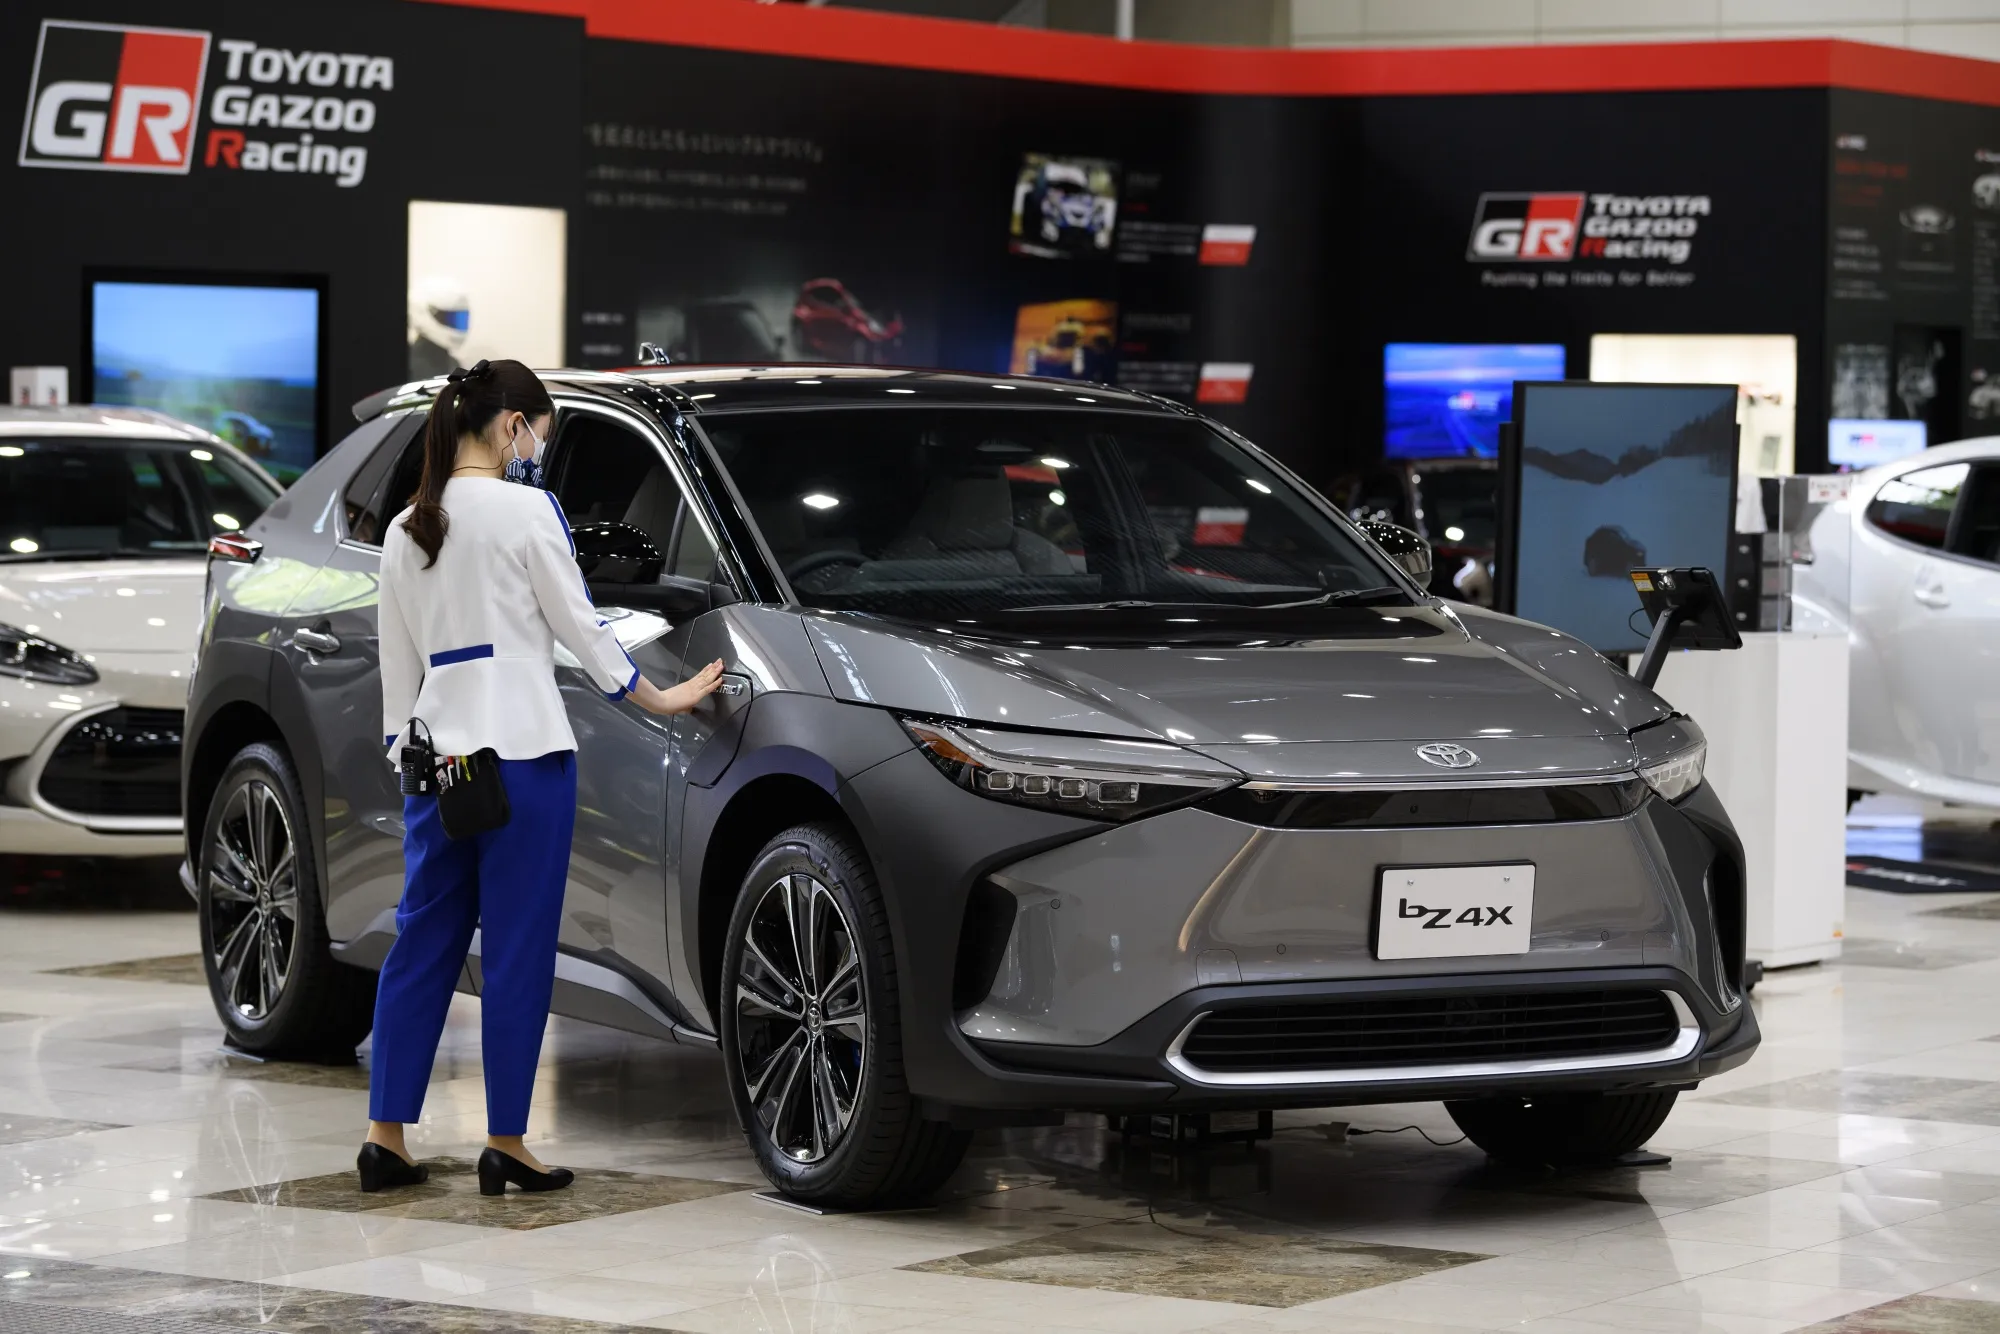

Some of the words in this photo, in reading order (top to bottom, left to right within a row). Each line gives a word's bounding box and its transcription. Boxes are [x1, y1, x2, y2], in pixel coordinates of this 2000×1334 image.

[220, 40, 393, 90] TOYOTA
[31, 81, 191, 162] GR
[212, 86, 375, 132] GAZOO
[206, 131, 367, 187] Racing
[1591, 194, 1711, 217] TOYOTA
[1474, 219, 1576, 258] GR
[1586, 217, 1697, 238] GAZOO
[1580, 237, 1691, 263] Racing
